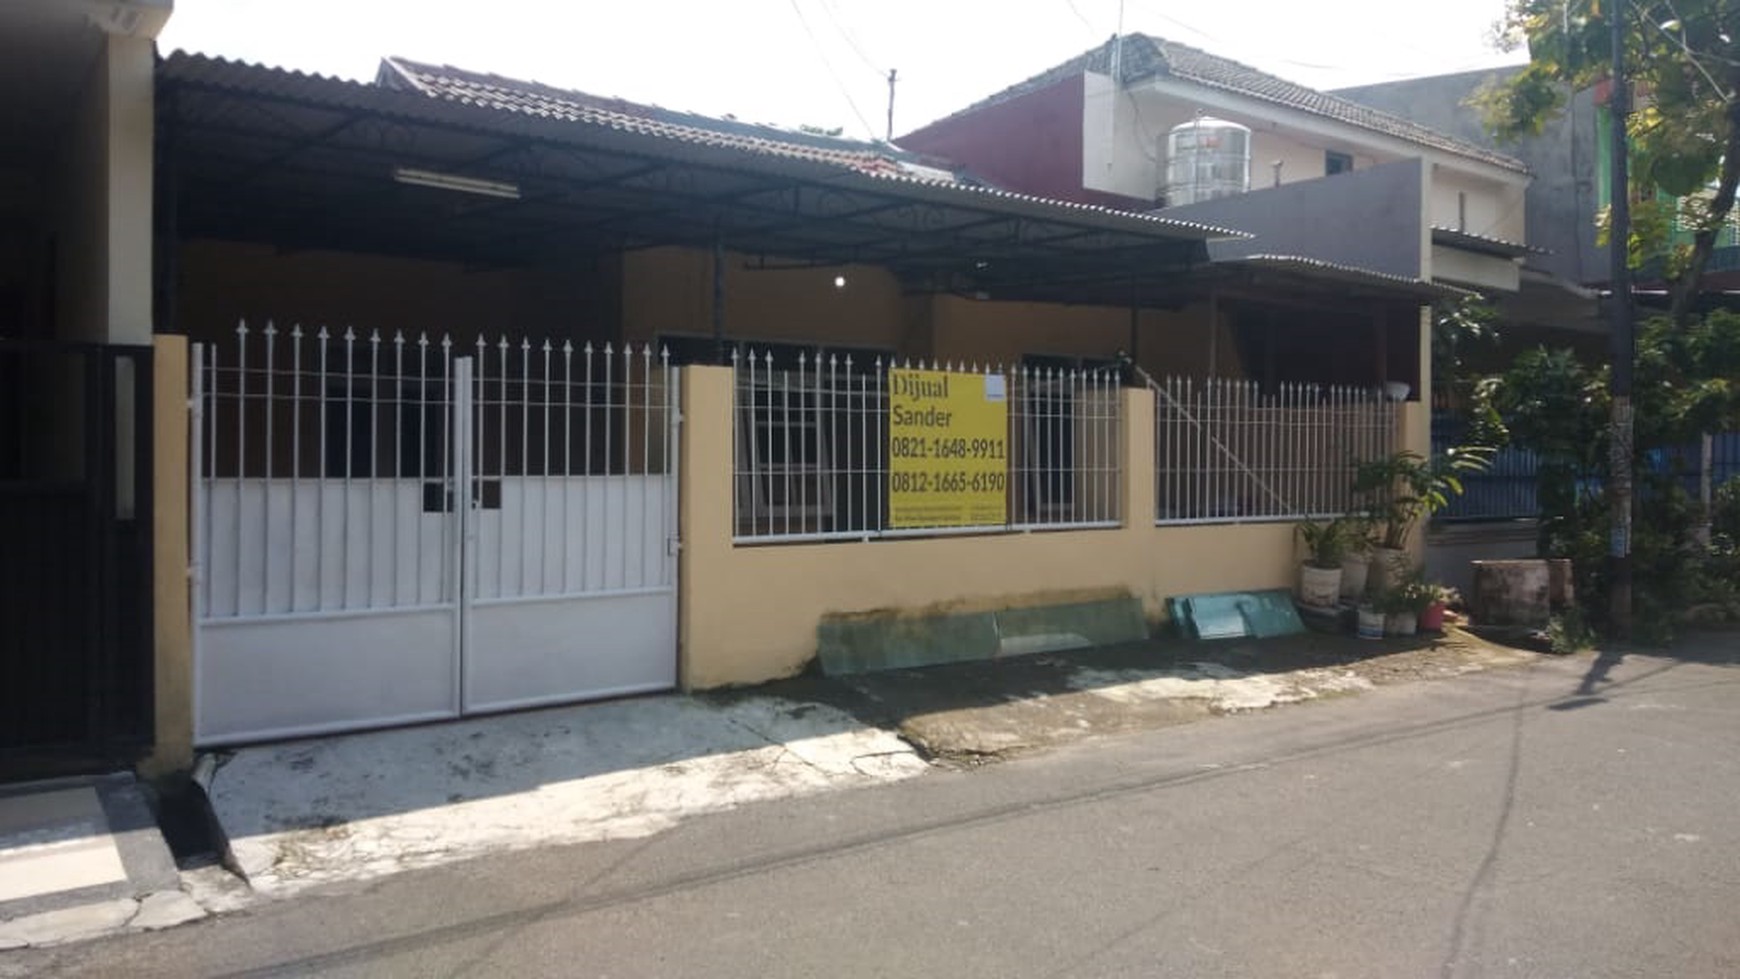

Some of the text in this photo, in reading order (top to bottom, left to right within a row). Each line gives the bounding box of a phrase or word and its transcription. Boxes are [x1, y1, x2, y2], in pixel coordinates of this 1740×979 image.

[892, 373, 949, 401] Dijual
[893, 405, 952, 427] Sander
[892, 436, 1005, 459] 0821-1648-9911
[892, 472, 1005, 493] 0812-1665-6190
